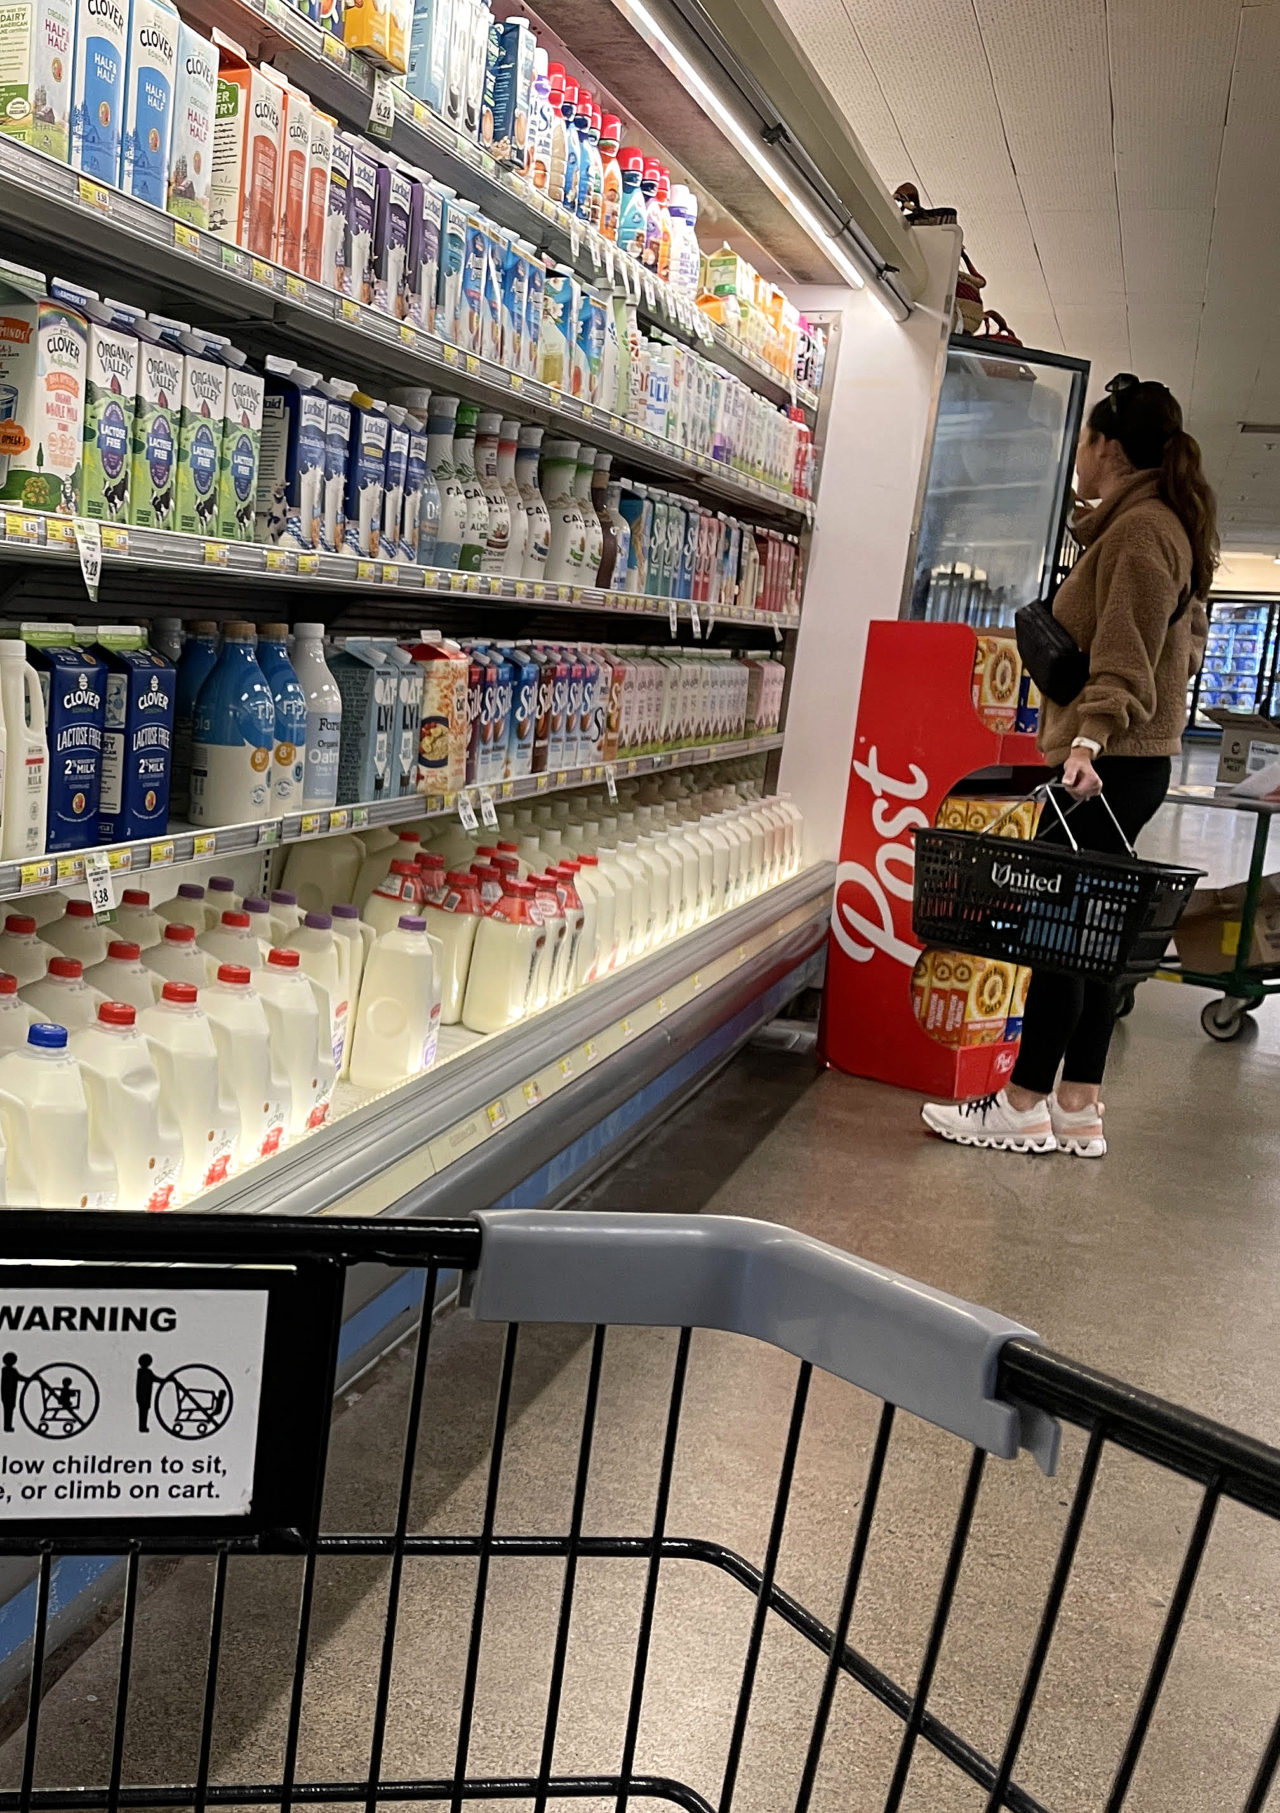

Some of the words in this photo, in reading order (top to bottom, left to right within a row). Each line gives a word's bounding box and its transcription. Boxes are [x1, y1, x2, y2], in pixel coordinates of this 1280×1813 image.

[0, 11, 26, 24] DAIRY
[48, 33, 68, 52] HALF
[140, 29, 173, 68] CLOVER
[97, 65, 116, 84] HALF
[186, 57, 214, 88] CLOVER
[148, 94, 164, 111] HALF
[255, 102, 280, 133] CLOVER
[47, 337, 80, 362] CLOVER
[96, 340, 135, 367] ORGANIC
[100, 357, 131, 379] VALLEY
[146, 357, 179, 384] ORGANIC
[150, 373, 176, 395] VALLEY
[190, 370, 222, 394] ORGANIC
[193, 384, 218, 404] VALLEY
[232, 382, 260, 405] ORGANIC
[234, 395, 257, 415] VALLEY
[101, 424, 126, 440] LACTOSE
[106, 436, 121, 449] FREE
[149, 436, 172, 451] LACTOSE
[154, 448, 168, 460] FREE
[63, 691, 100, 710] CLOVER
[138, 693, 169, 710] CLOVER
[57, 727, 88, 751] LACTOSE
[89, 727, 102, 749] FREE
[76, 762, 95, 774] MILK
[830, 745, 928, 967] Post
[992, 862, 1061, 893] United
[52, 1455, 151, 1475] children
[161, 1457, 183, 1474] to
[191, 1455, 227, 1477] sit,
[21, 1483, 47, 1500] or
[54, 1480, 121, 1499] climb
[129, 1483, 159, 1498] on
[167, 1482, 220, 1499] cart.
